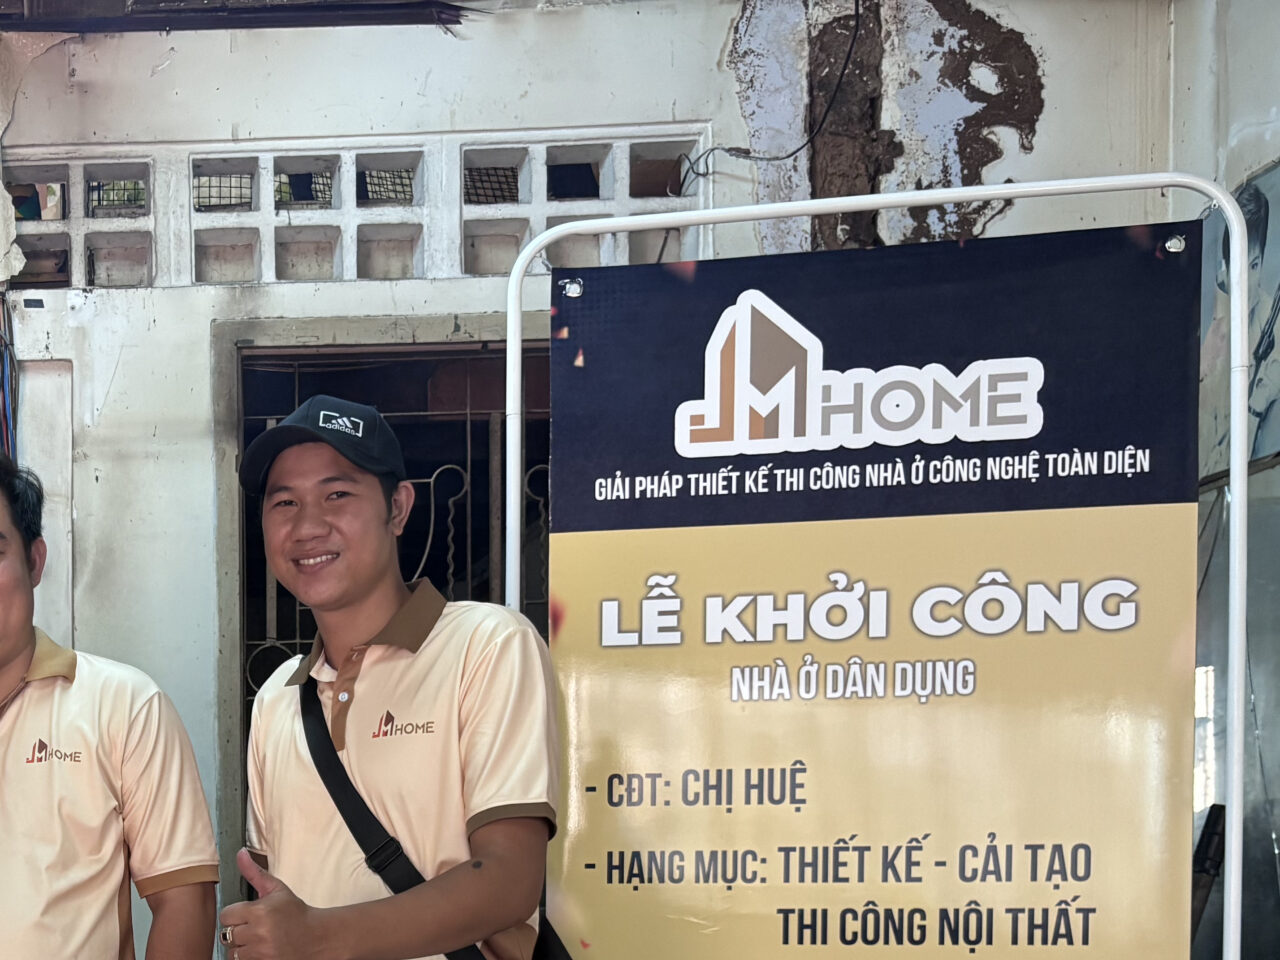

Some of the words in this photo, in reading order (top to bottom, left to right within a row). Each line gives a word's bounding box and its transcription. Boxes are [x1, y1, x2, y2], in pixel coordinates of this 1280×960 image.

[325, 422, 356, 436] adidas
[594, 470, 630, 500] GIẢI
[634, 470, 683, 499] PHÁP
[687, 465, 740, 497] THIẾT
[744, 463, 773, 494] KẾ
[774, 468, 804, 493] THI
[809, 461, 860, 490] CÔNG
[865, 457, 906, 488] NHÀ
[911, 454, 924, 484] Ở
[928, 454, 981, 484] CÔNG
[987, 450, 1040, 483] NGHỆ
[1045, 448, 1098, 478] TOÀN
[1103, 444, 1151, 478] DIỆN
[601, 574, 682, 647] LỄ
[704, 571, 888, 643] KHỞI
[912, 570, 1137, 637] CÔNG
[730, 658, 791, 701] NHÀ
[798, 655, 819, 700] Ở
[825, 656, 885, 699] DÂN
[893, 659, 975, 703] DỤNG
[606, 773, 672, 808] CĐT:
[681, 767, 734, 813] CHỊ
[744, 759, 808, 812] HUỆ
[605, 850, 686, 891] HẠNG
[694, 849, 768, 891] MỤC:
[777, 834, 872, 885] THIẾT
[881, 833, 932, 884] KẾ
[958, 831, 1013, 883] CẢI
[1024, 842, 1092, 890] TẠO
[777, 907, 829, 946] THI
[839, 900, 927, 947] CÔNG
[938, 900, 994, 954] NỘI
[1005, 895, 1097, 947] THẤT
